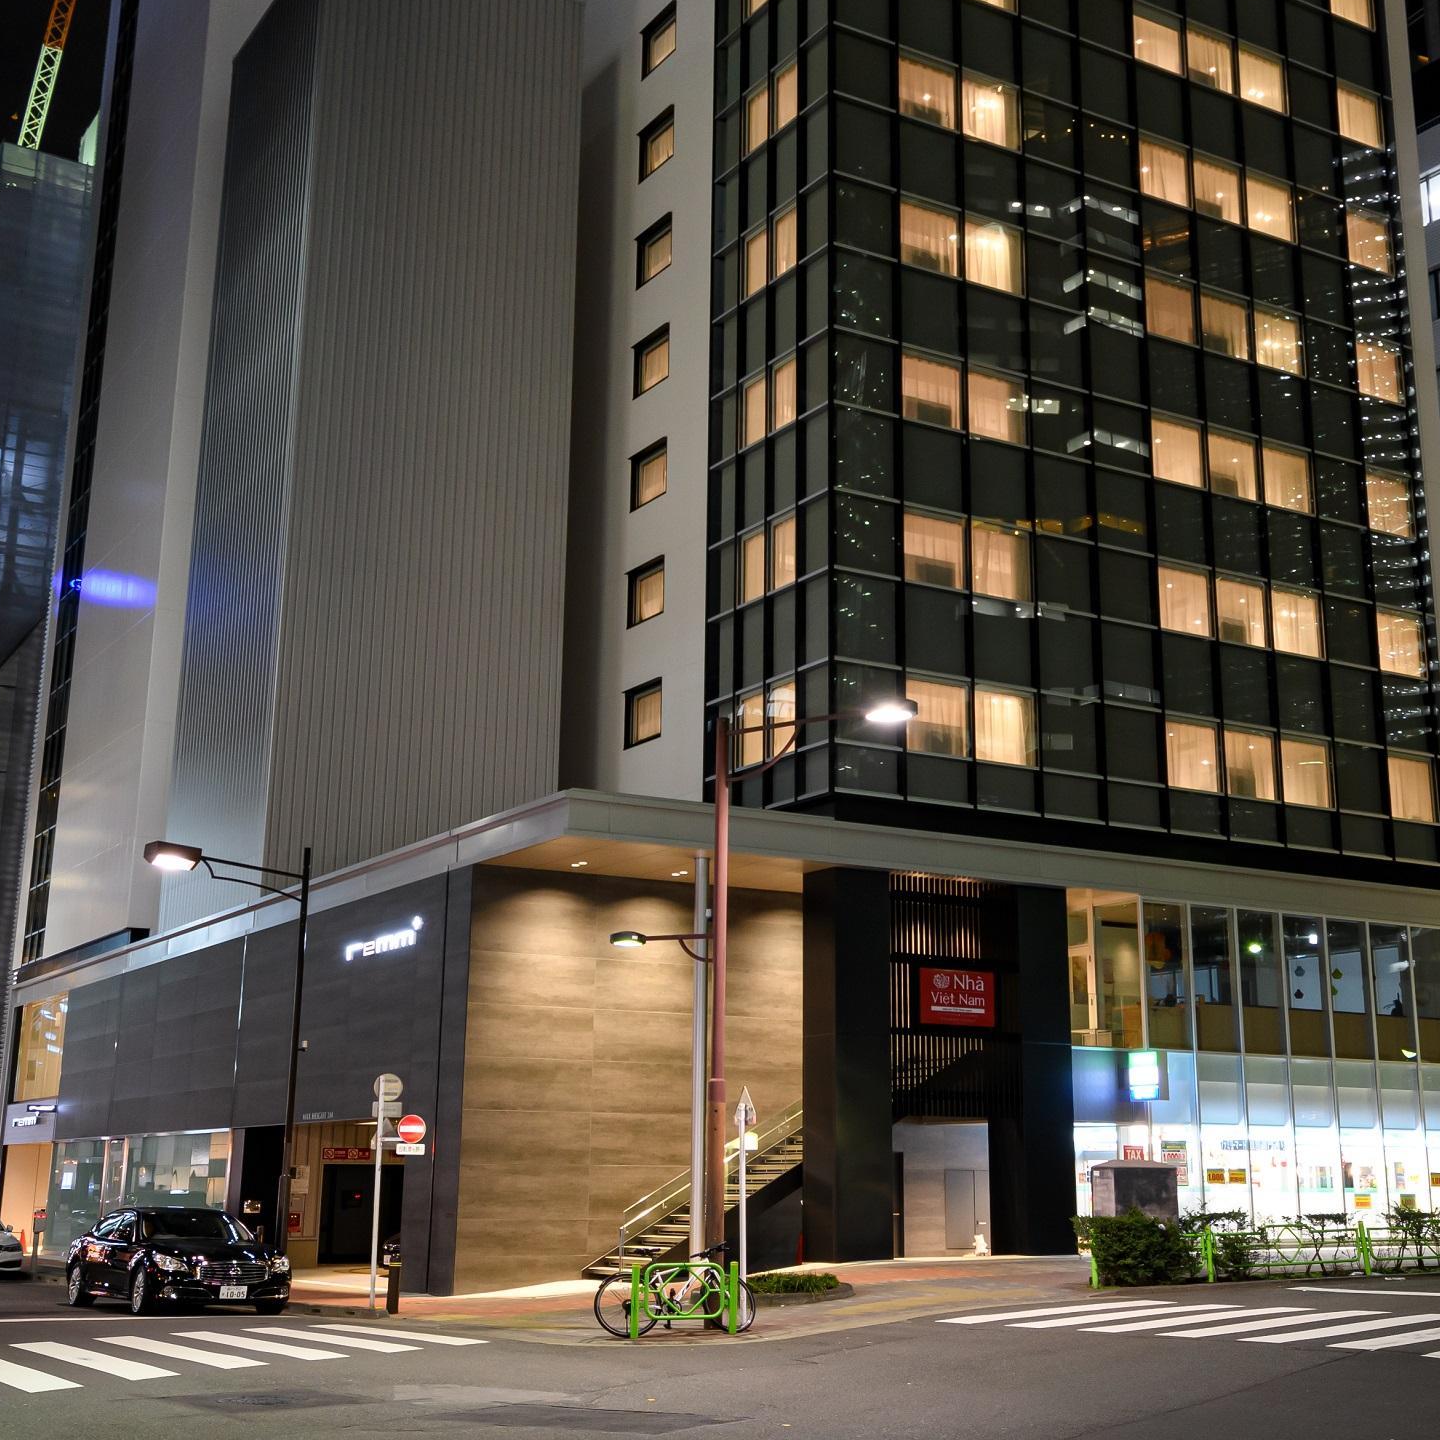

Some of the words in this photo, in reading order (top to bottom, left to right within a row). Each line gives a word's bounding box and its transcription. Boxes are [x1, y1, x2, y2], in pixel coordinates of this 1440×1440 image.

[953, 974, 985, 992] Nhà
[959, 993, 985, 1007] Nam
[1125, 1149, 1142, 1160] TAX
